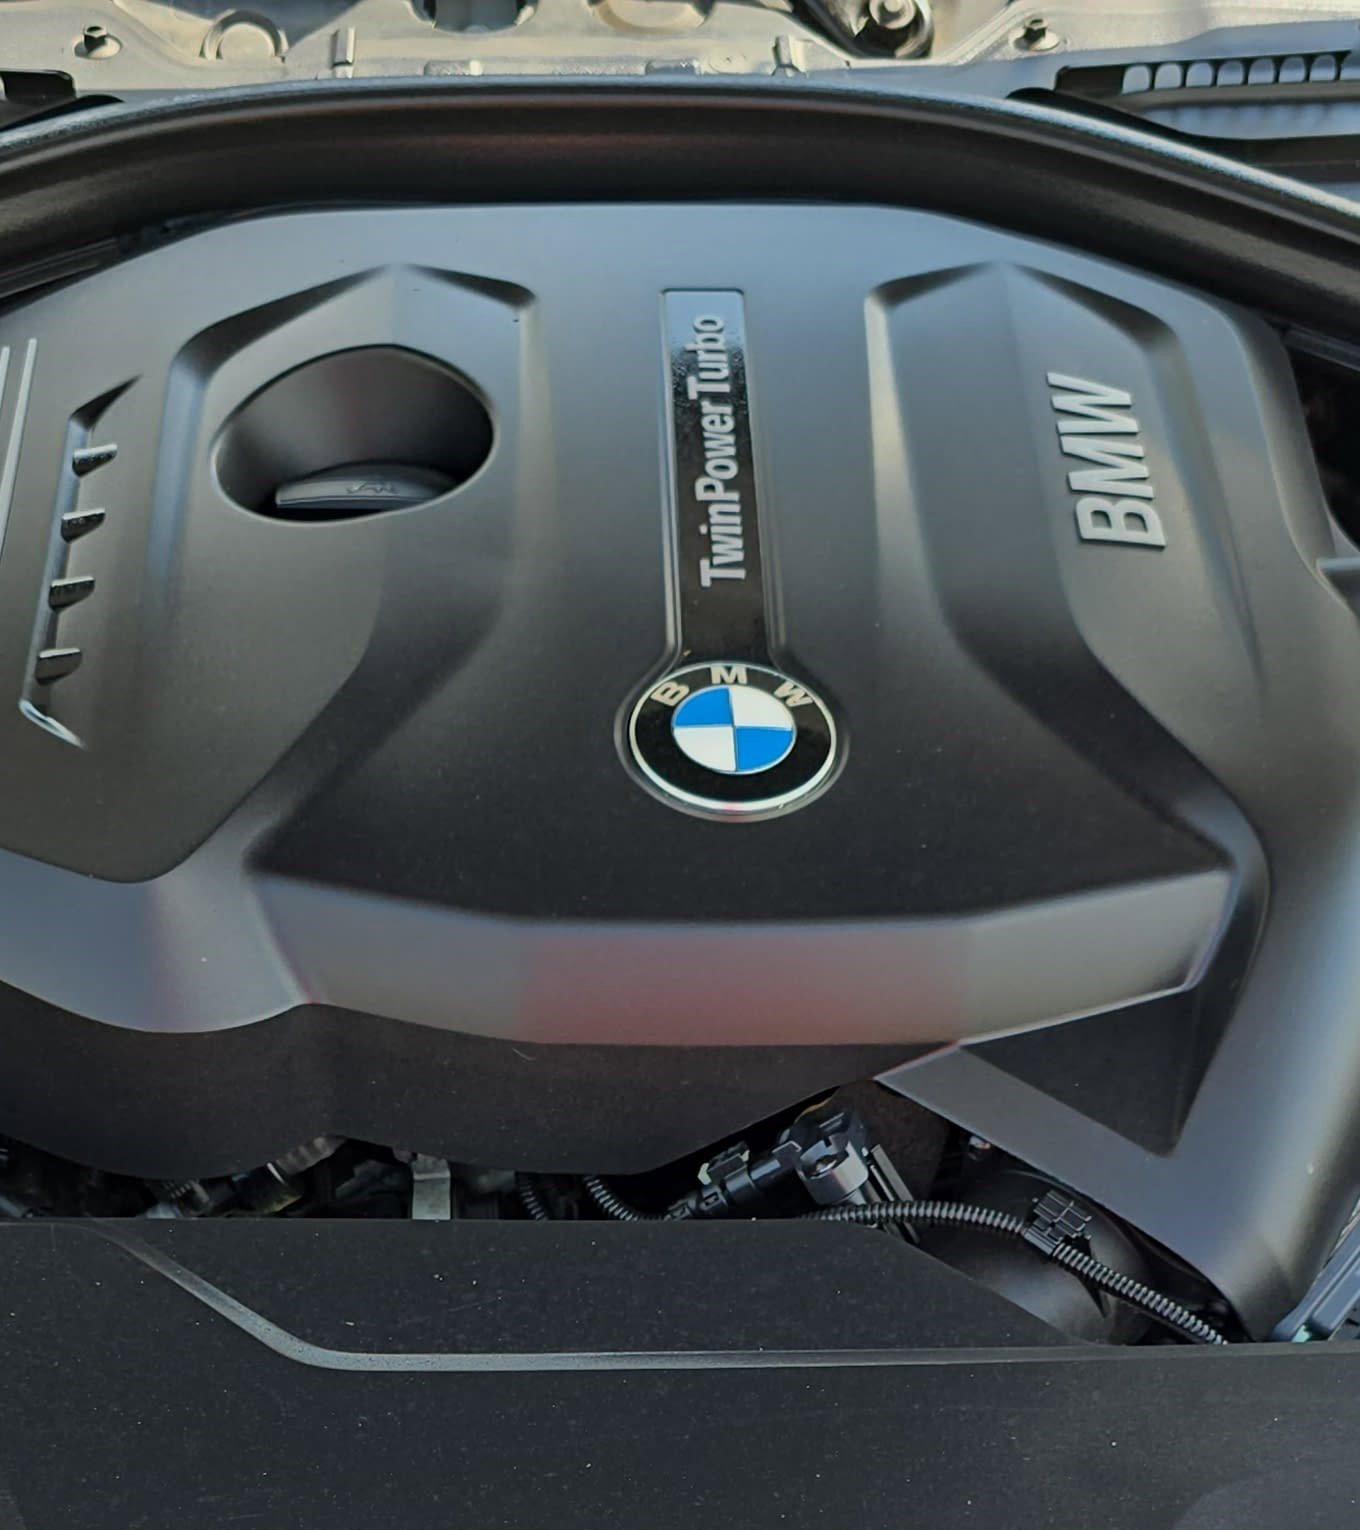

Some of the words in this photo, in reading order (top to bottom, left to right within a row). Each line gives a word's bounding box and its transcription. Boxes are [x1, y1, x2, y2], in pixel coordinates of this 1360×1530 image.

[685, 314, 733, 400] Turbo
[694, 400, 747, 588] TwinPower
[1047, 371, 1167, 549] BMW
[650, 664, 814, 708] BMW
